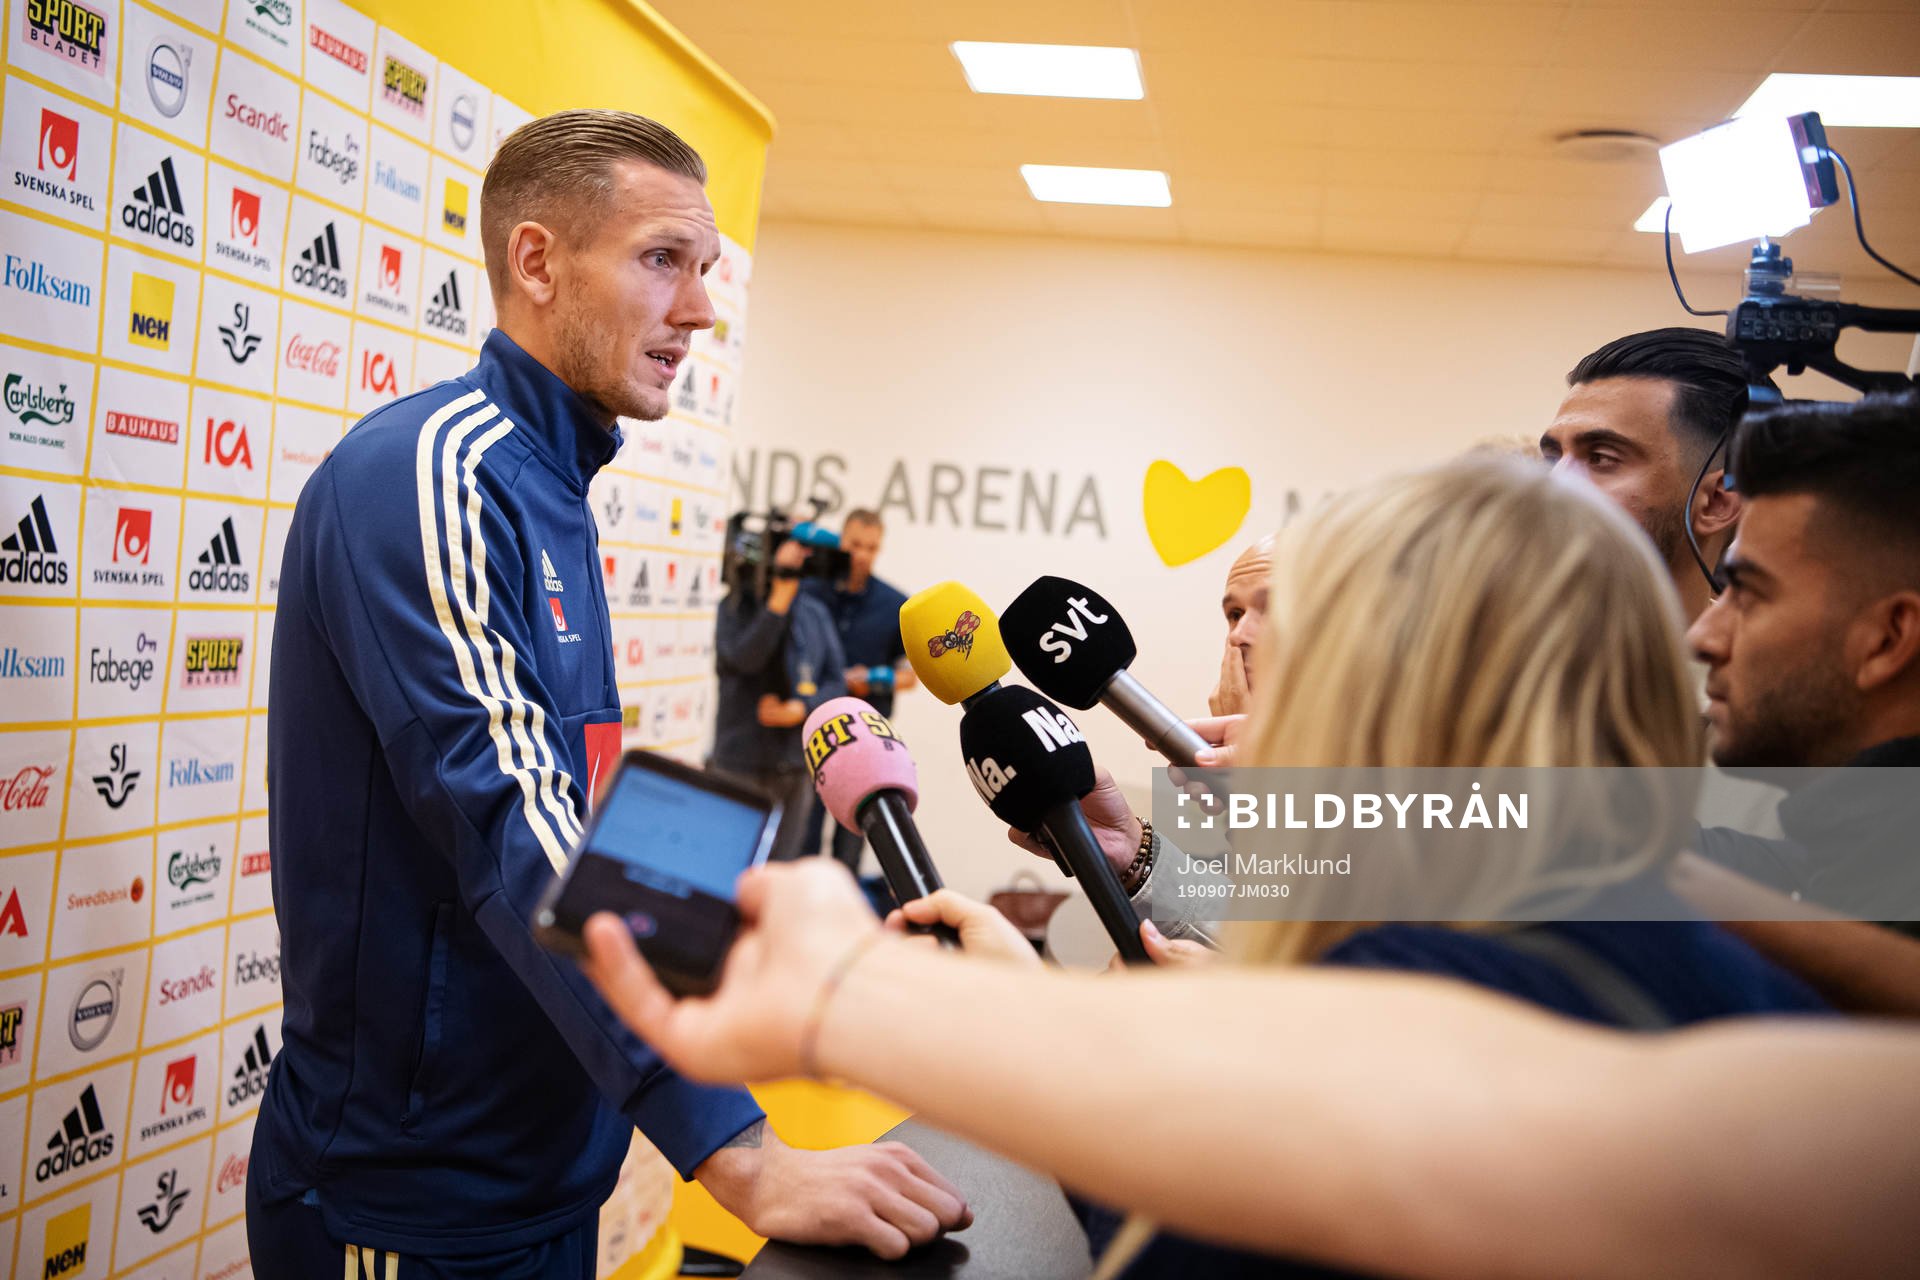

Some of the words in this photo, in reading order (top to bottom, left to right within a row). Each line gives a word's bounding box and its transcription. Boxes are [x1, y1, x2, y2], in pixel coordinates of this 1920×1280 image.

[27, 0, 106, 57] SPORT
[30, 28, 101, 69] BLADET
[225, 94, 288, 142] Scandic
[14, 171, 66, 201] SVENSKA
[70, 190, 95, 211] SPEL
[122, 202, 195, 247] adidas
[4, 255, 91, 307] Folksam
[291, 262, 348, 299] adidas
[234, 302, 250, 332] SJ
[425, 309, 467, 336] adidas
[361, 350, 398, 397] ICA
[3, 373, 75, 425] Carlsberg
[107, 412, 178, 443] BAUHAUS
[204, 418, 253, 470] ICA
[876, 458, 1108, 540] ARENA
[93, 570, 138, 584] SVENSKA
[142, 574, 164, 586] SPEL
[189, 565, 249, 592] adidas
[1039, 597, 1109, 664] svt
[0, 647, 64, 678] lksam
[91, 648, 153, 691] Fabege
[186, 639, 243, 673] SPORT
[110, 743, 127, 773] SJ
[804, 713, 858, 784] RT
[169, 758, 234, 788] Folksam
[0, 887, 28, 938] A
[67, 887, 128, 911] Swedbank
[160, 965, 216, 1005] Scandic
[235, 951, 281, 985] Fabeg
[141, 1118, 184, 1141] SVENSKA
[36, 1132, 114, 1183] adidas
[156, 1167, 178, 1199] SJ
